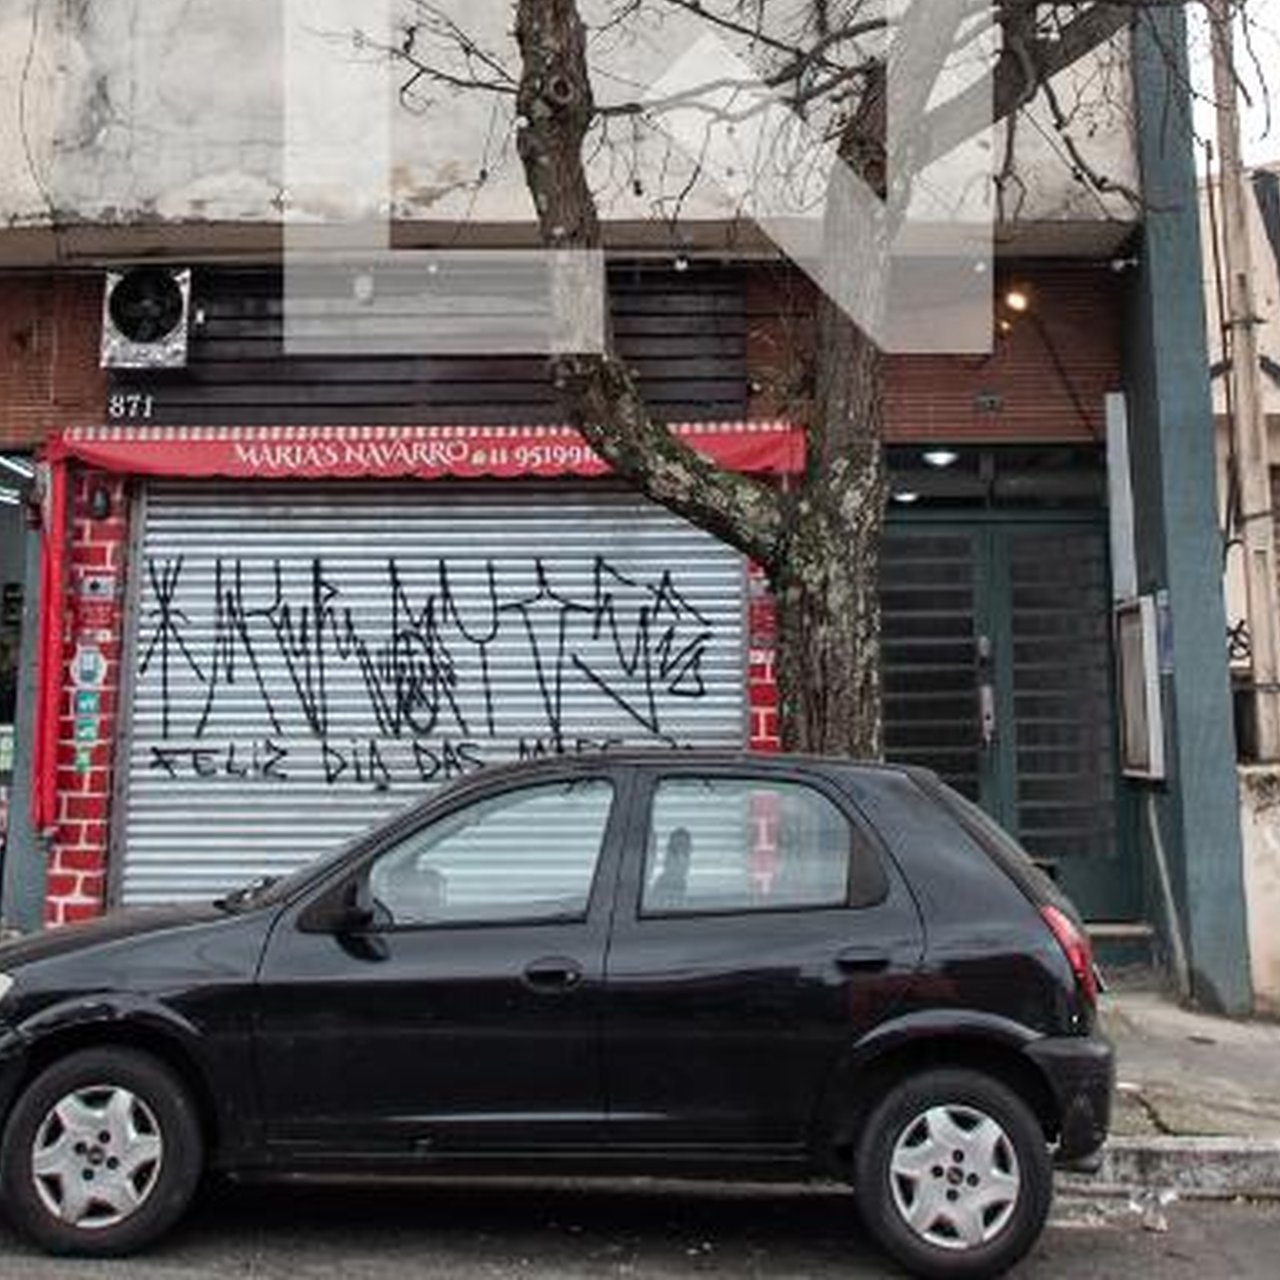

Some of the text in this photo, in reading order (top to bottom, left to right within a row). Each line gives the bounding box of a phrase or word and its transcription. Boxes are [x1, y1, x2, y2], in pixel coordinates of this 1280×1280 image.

[109, 394, 154, 418] 871
[234, 440, 338, 468] MARIA'S
[342, 437, 470, 468] NAVARRO
[419, 740, 485, 781] DAS
